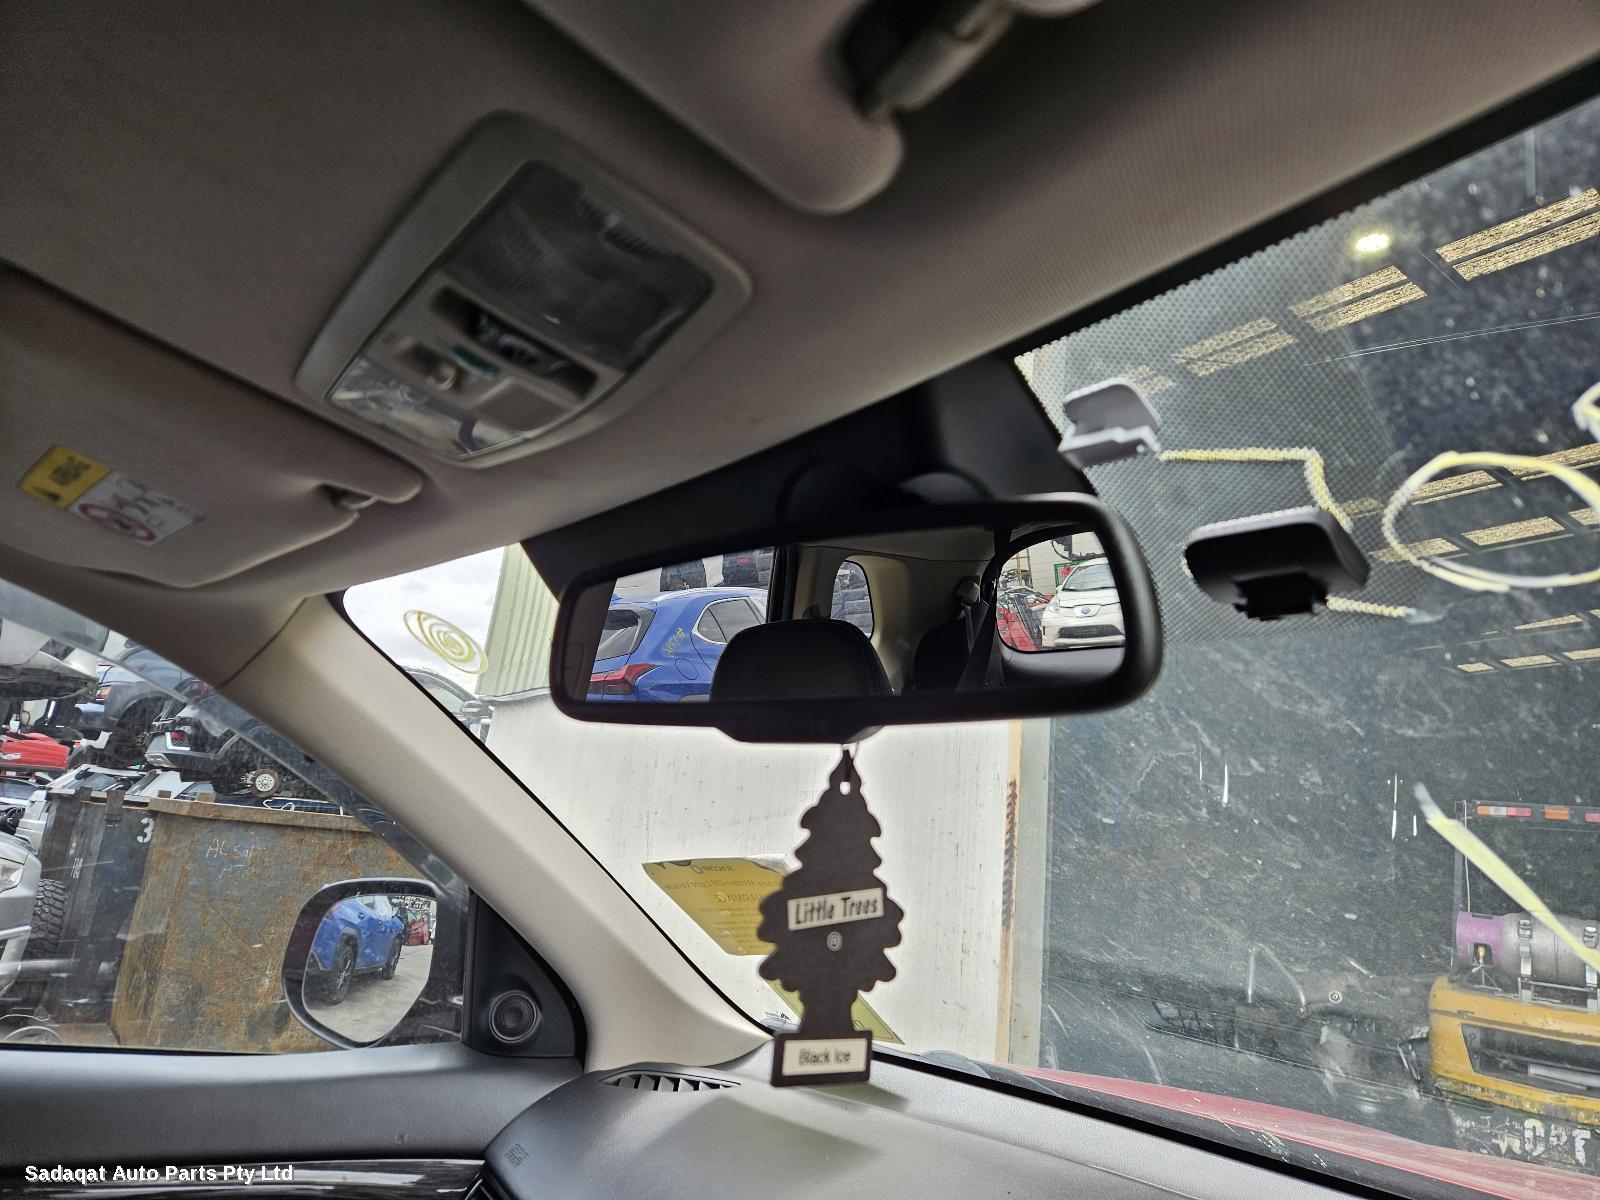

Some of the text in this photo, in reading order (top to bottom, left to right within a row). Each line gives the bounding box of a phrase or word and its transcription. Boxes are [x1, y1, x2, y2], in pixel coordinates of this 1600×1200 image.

[136, 817, 155, 843] 3
[796, 896, 878, 925] Little Trees
[799, 1048, 851, 1066] Black Ice
